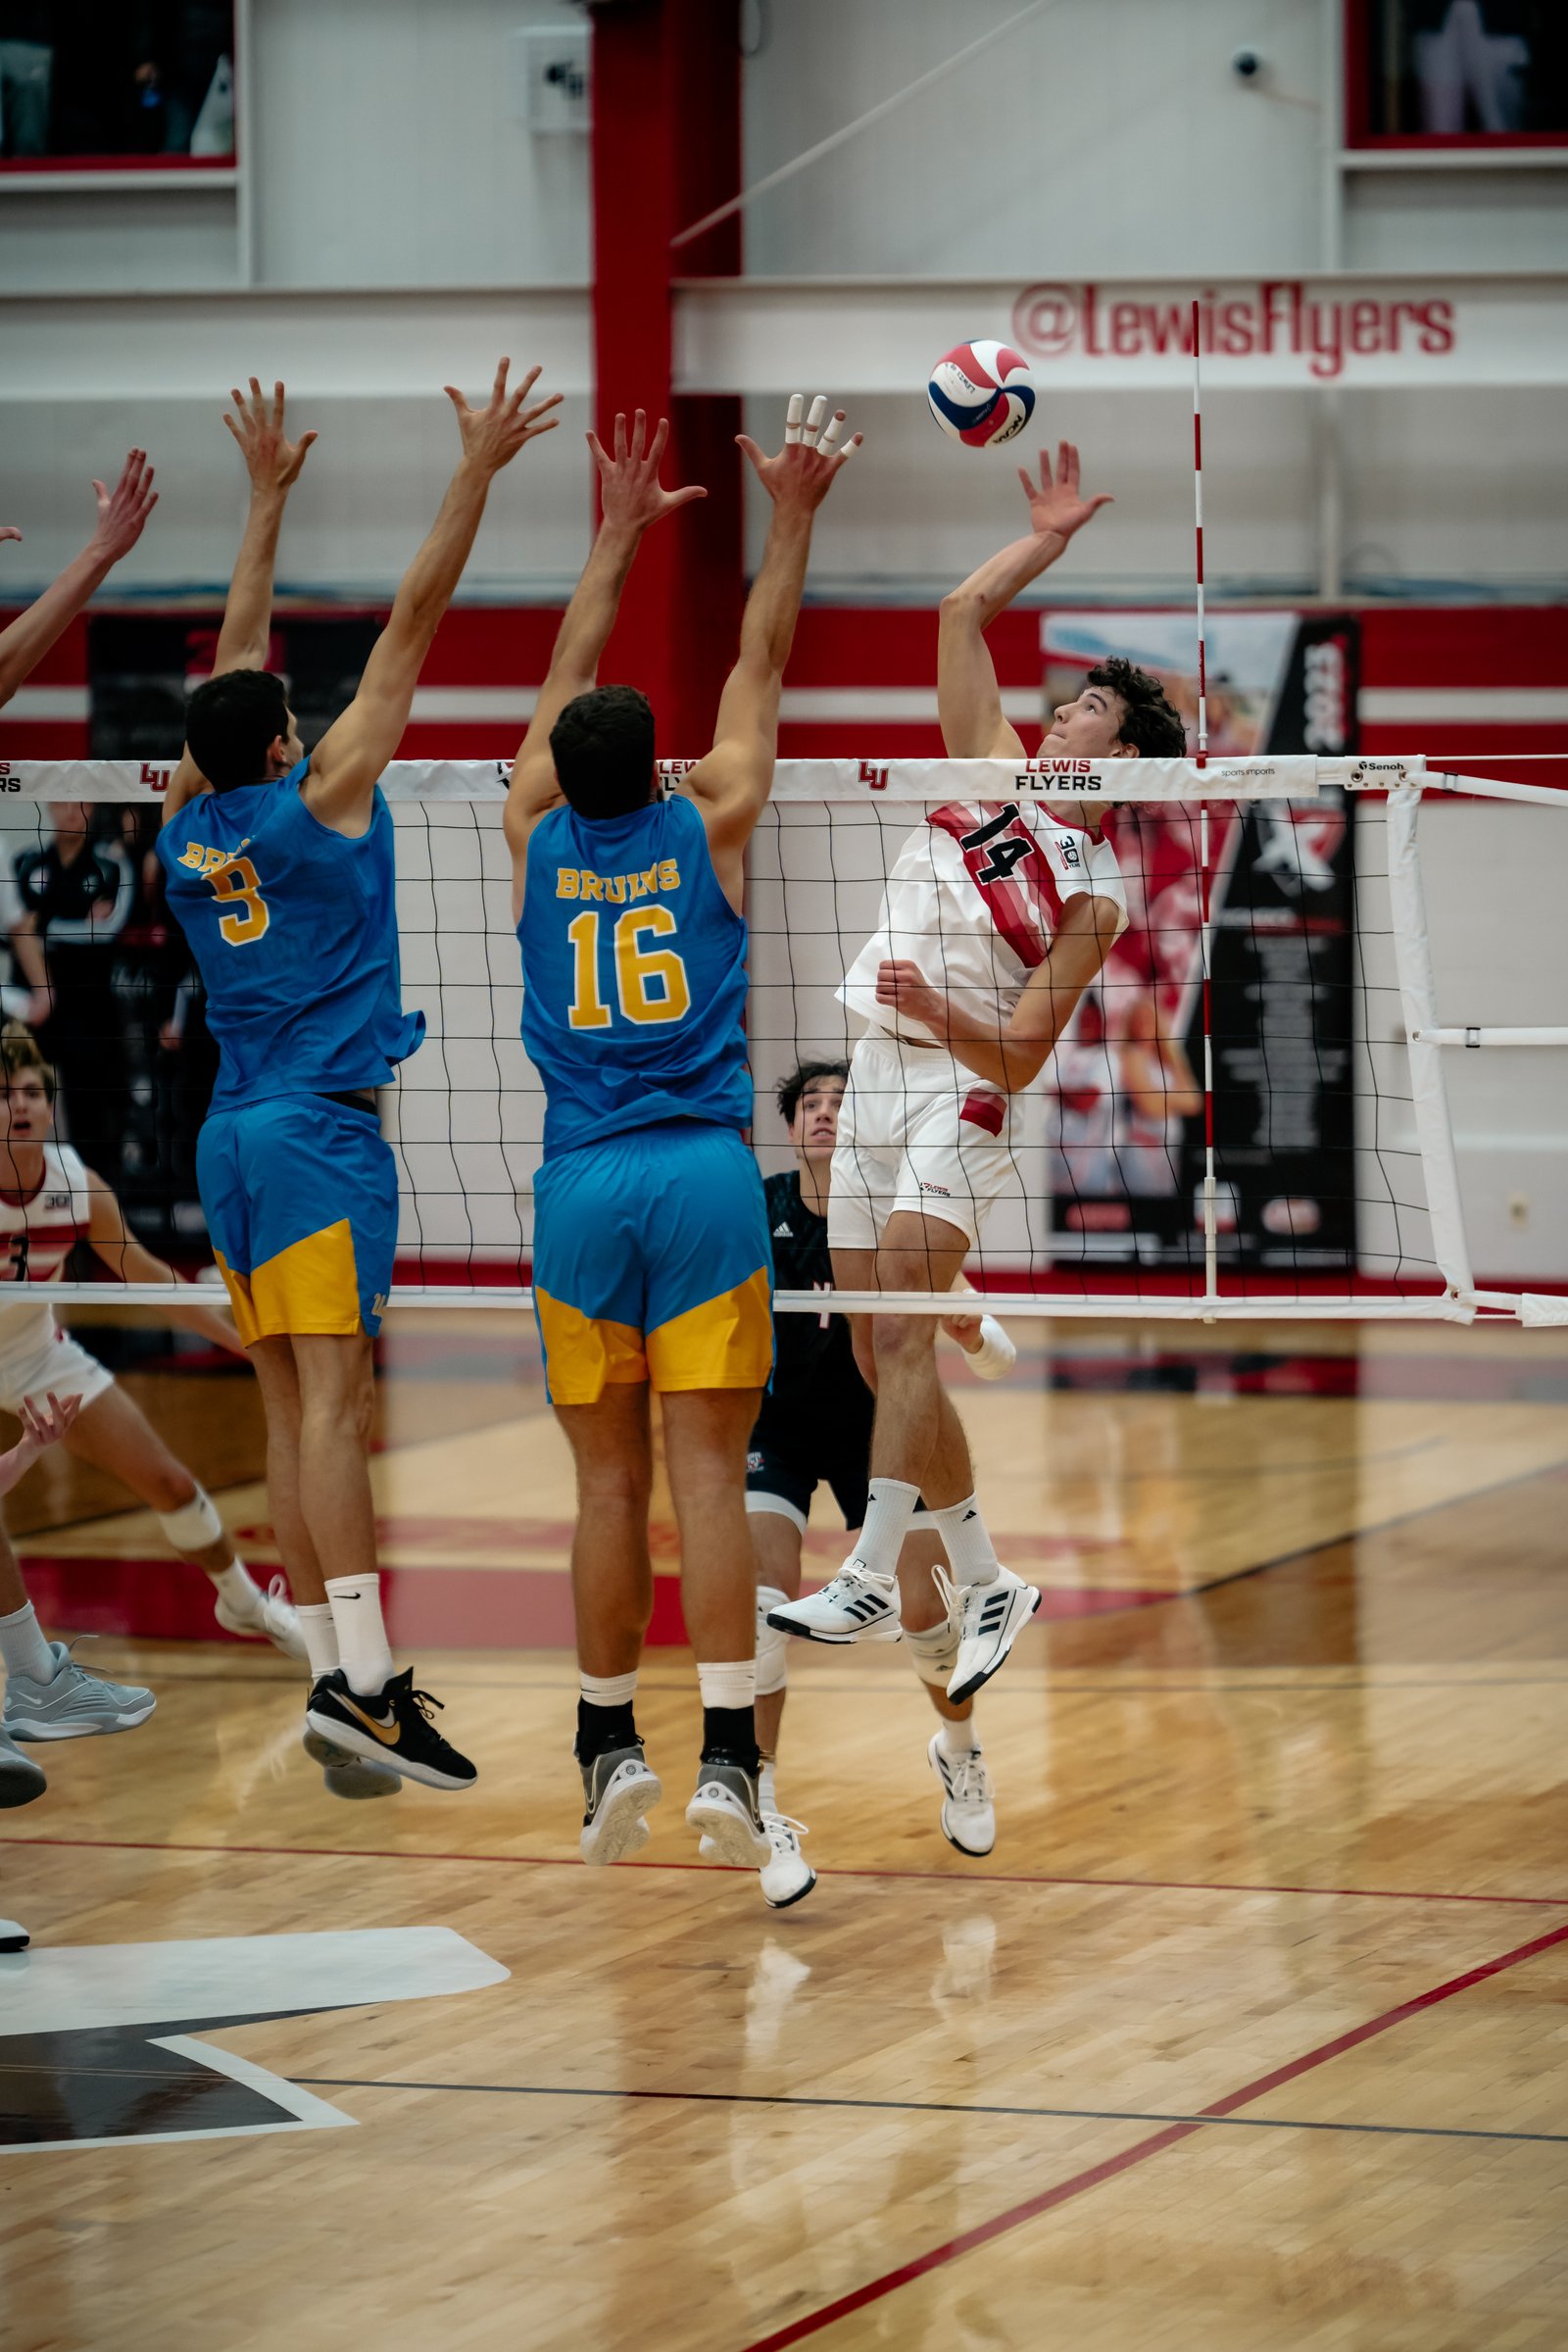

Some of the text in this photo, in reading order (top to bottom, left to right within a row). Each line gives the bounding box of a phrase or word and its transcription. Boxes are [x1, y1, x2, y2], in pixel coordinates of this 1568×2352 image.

[140, 762, 170, 792] LU
[858, 760, 889, 791] LU
[1015, 775, 1102, 791] FLYERS
[1025, 760, 1091, 773] LEWIS
[959, 802, 1035, 886] 14
[556, 858, 680, 904] BRUINS
[201, 857, 270, 947] 9
[567, 904, 691, 1029] 16
